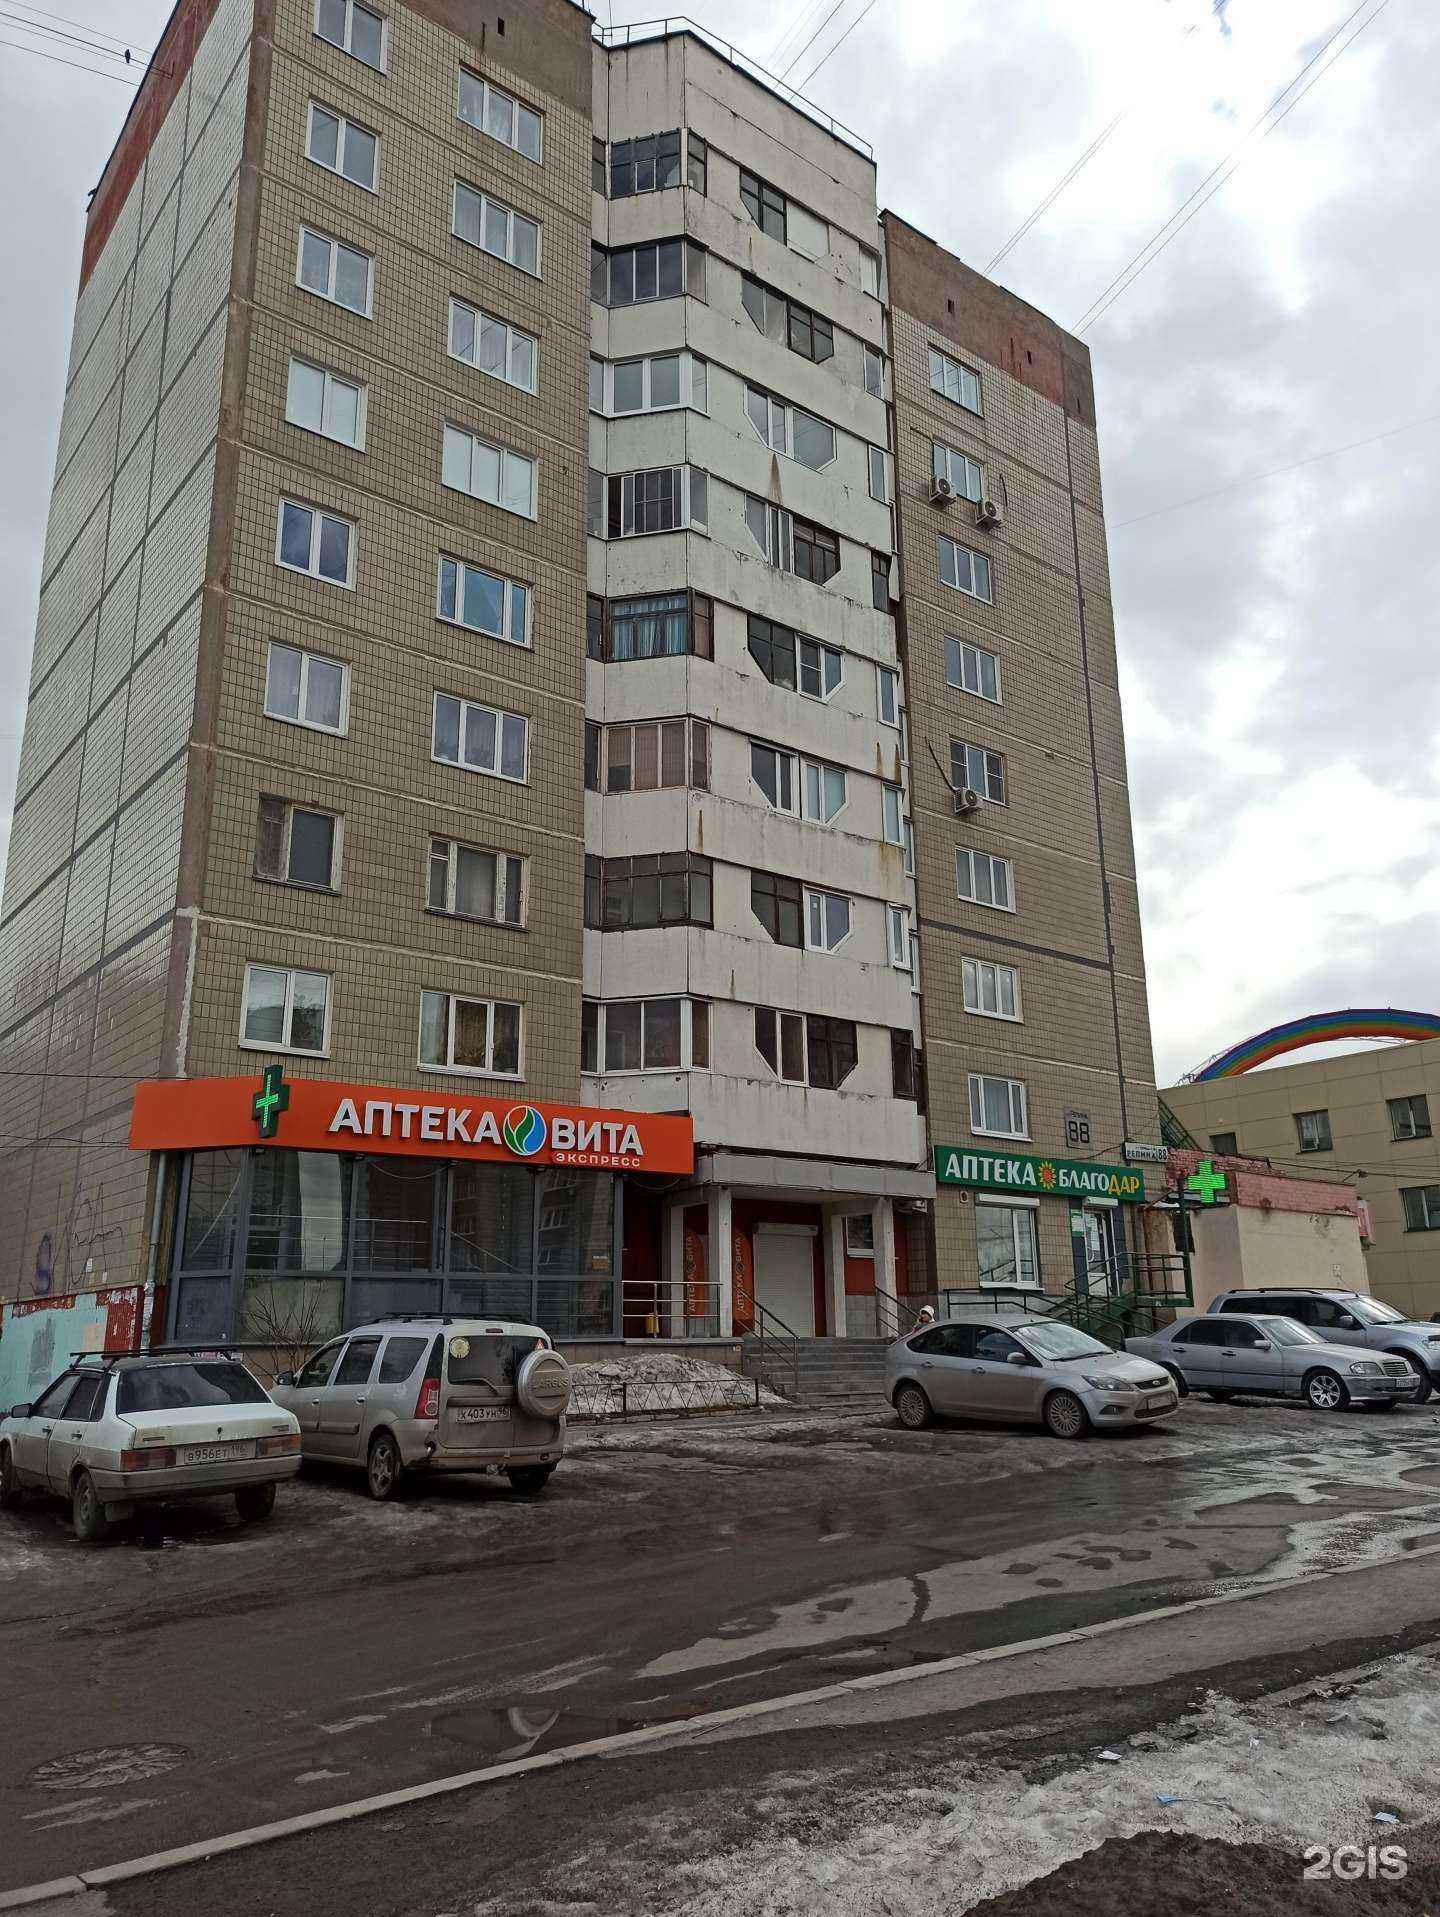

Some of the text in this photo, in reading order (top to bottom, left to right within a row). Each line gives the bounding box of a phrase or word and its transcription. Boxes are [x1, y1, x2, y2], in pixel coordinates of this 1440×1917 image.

[328, 1098, 644, 1156] АПТЕКА ВИТА
[1068, 1120, 1090, 1143] 88
[555, 1153, 641, 1168] ЭКСПРЕСС
[1126, 1149, 1156, 1160] РЕПИНА
[1158, 1148, 1168, 1160] 88
[945, 1153, 1141, 1196] АПТЕКА БЛАГОДАР
